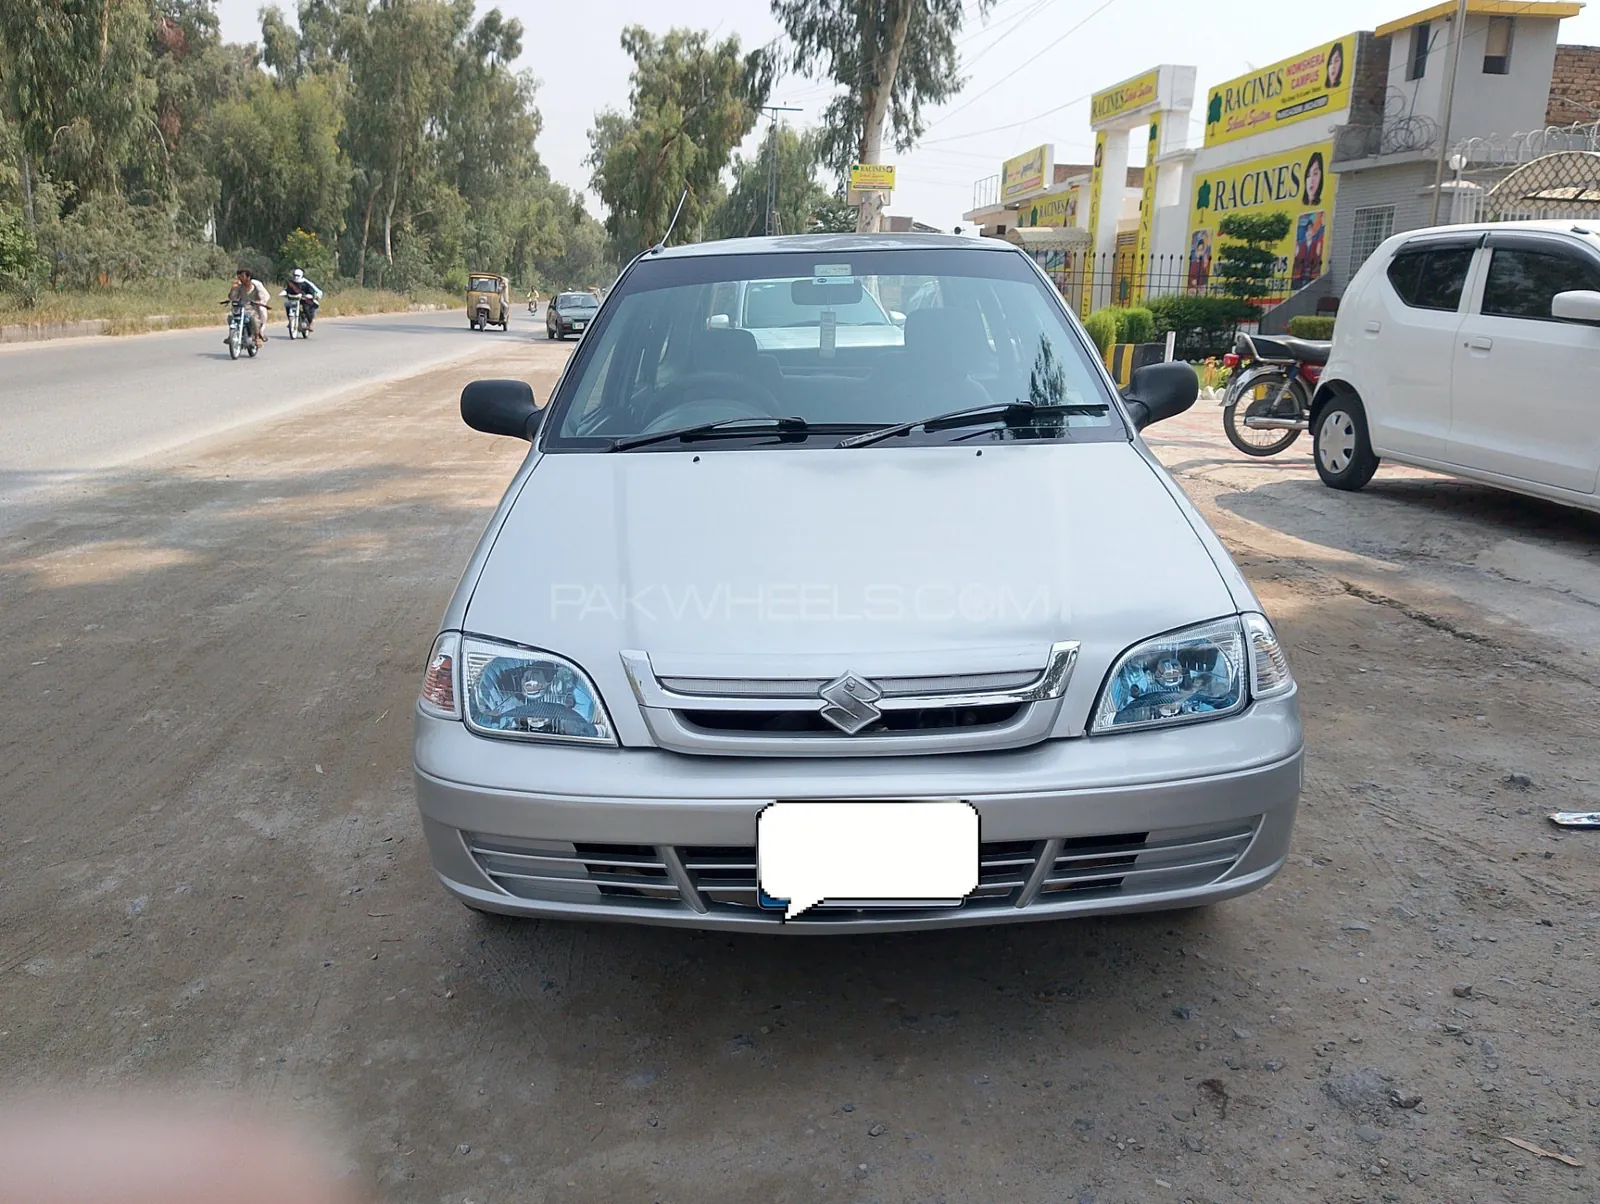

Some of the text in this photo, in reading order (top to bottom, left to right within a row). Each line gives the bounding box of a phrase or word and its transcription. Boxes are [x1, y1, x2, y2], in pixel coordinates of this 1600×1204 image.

[1224, 67, 1284, 113] RACINES
[1291, 69, 1320, 90] CAMPUS
[1092, 88, 1125, 119] RACINES
[1213, 162, 1302, 212] RACINES
